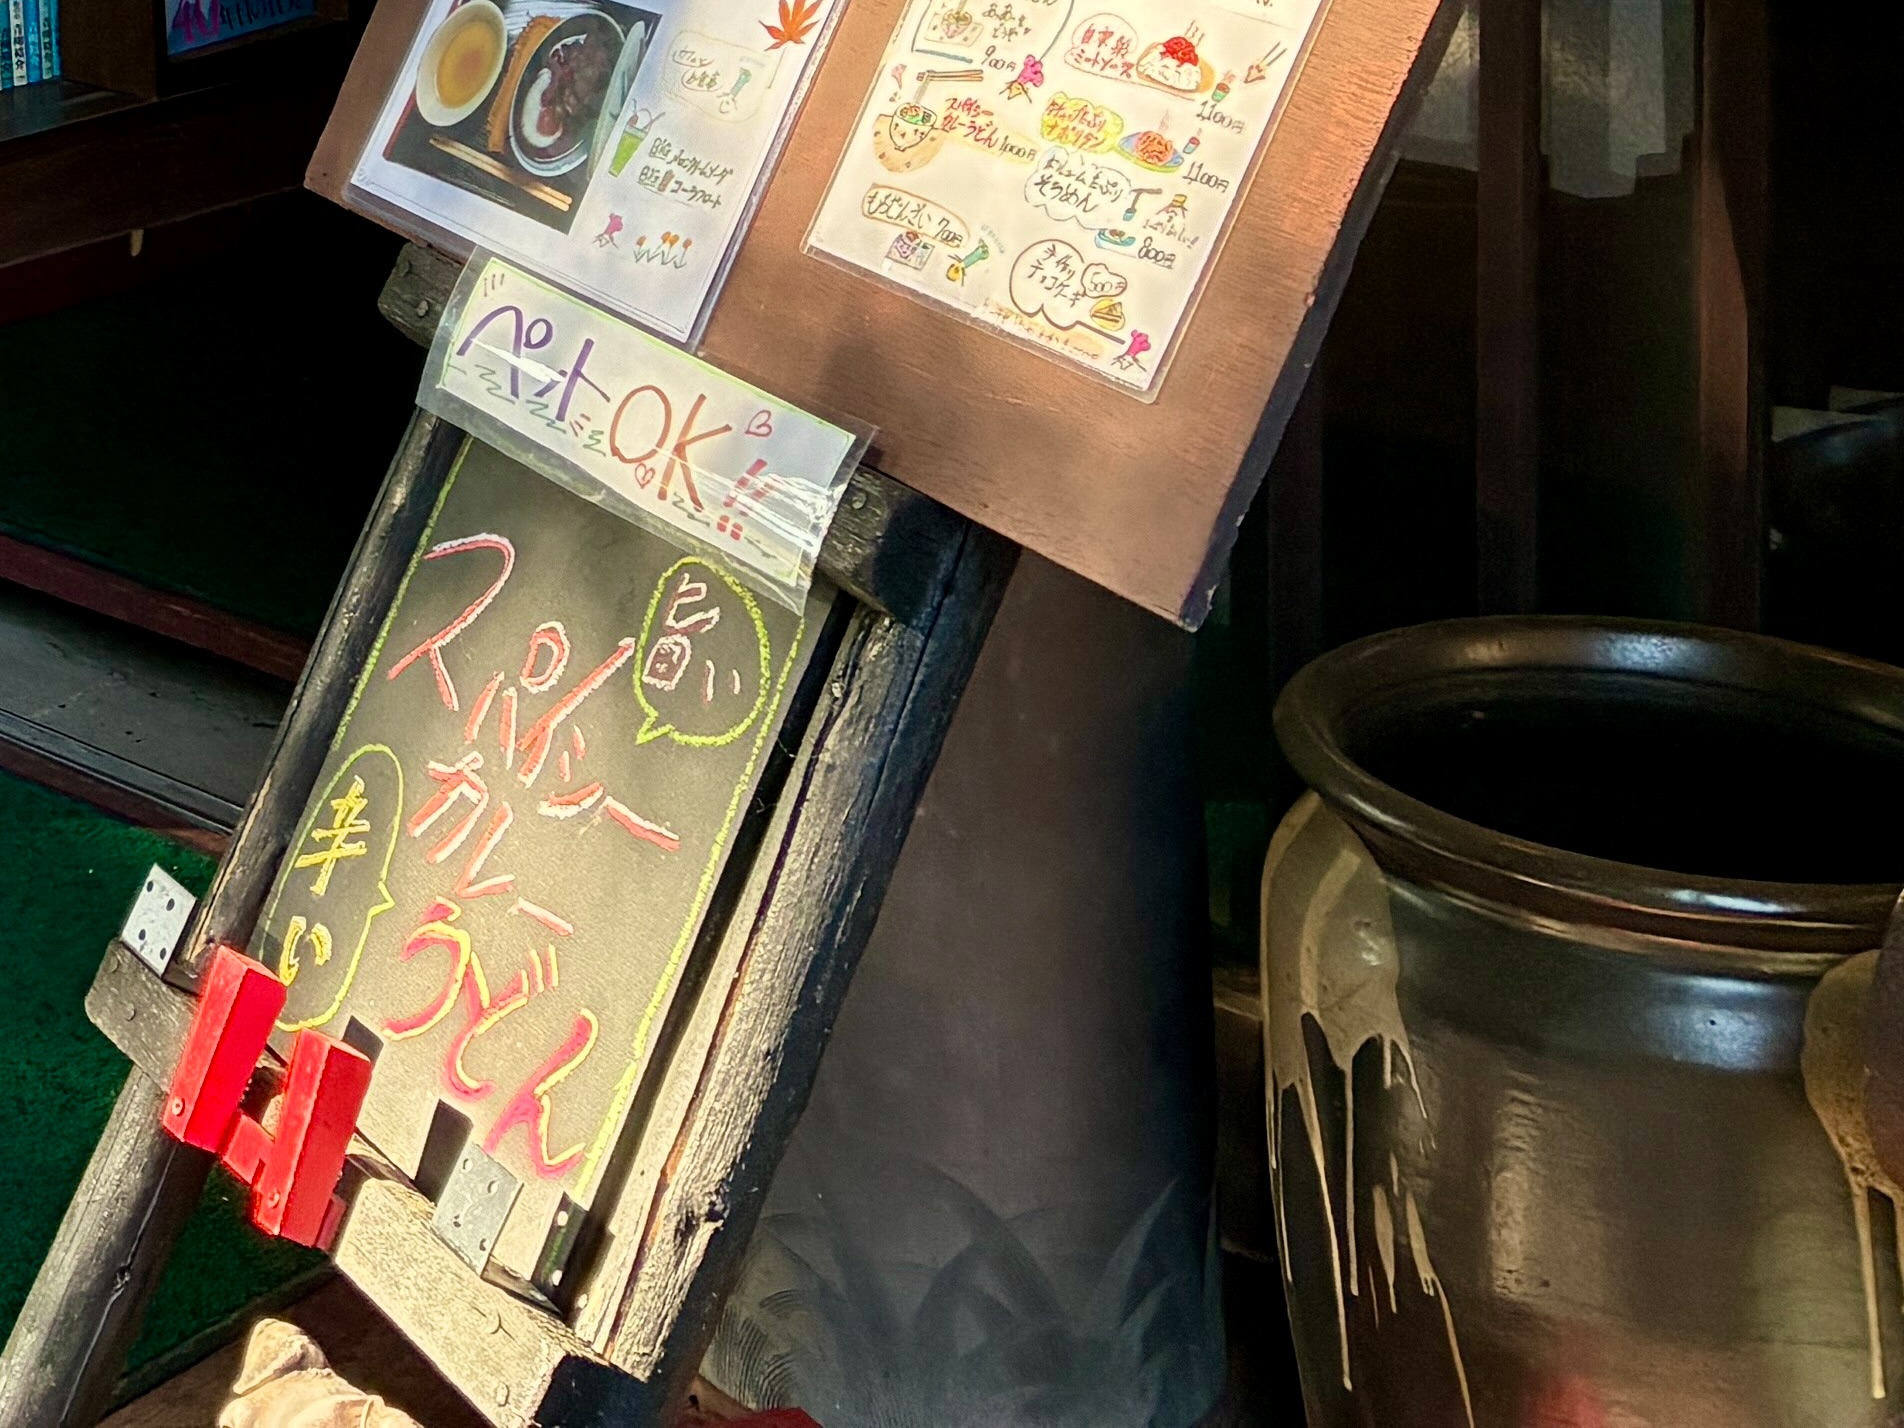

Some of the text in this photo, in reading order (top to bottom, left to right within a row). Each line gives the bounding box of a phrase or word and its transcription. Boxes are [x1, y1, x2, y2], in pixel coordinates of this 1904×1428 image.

[981, 45, 1017, 72] 900円
[1075, 49, 1135, 79] ミートソース
[942, 115, 998, 150] カレーうどん
[1196, 100, 1245, 134] 1100円
[1034, 174, 1099, 212] そうめん
[1182, 161, 1230, 193] 1100円
[937, 217, 964, 248] 700円
[1138, 236, 1176, 265] 800円
[1090, 271, 1126, 293] 500円
[456, 305, 611, 421] ペット
[610, 385, 732, 512] OK
[641, 573, 743, 704] 旨い
[389, 534, 681, 851] スパイシー
[408, 751, 576, 936] カレー
[279, 775, 370, 986] 辛い
[383, 897, 600, 1180] うどん
